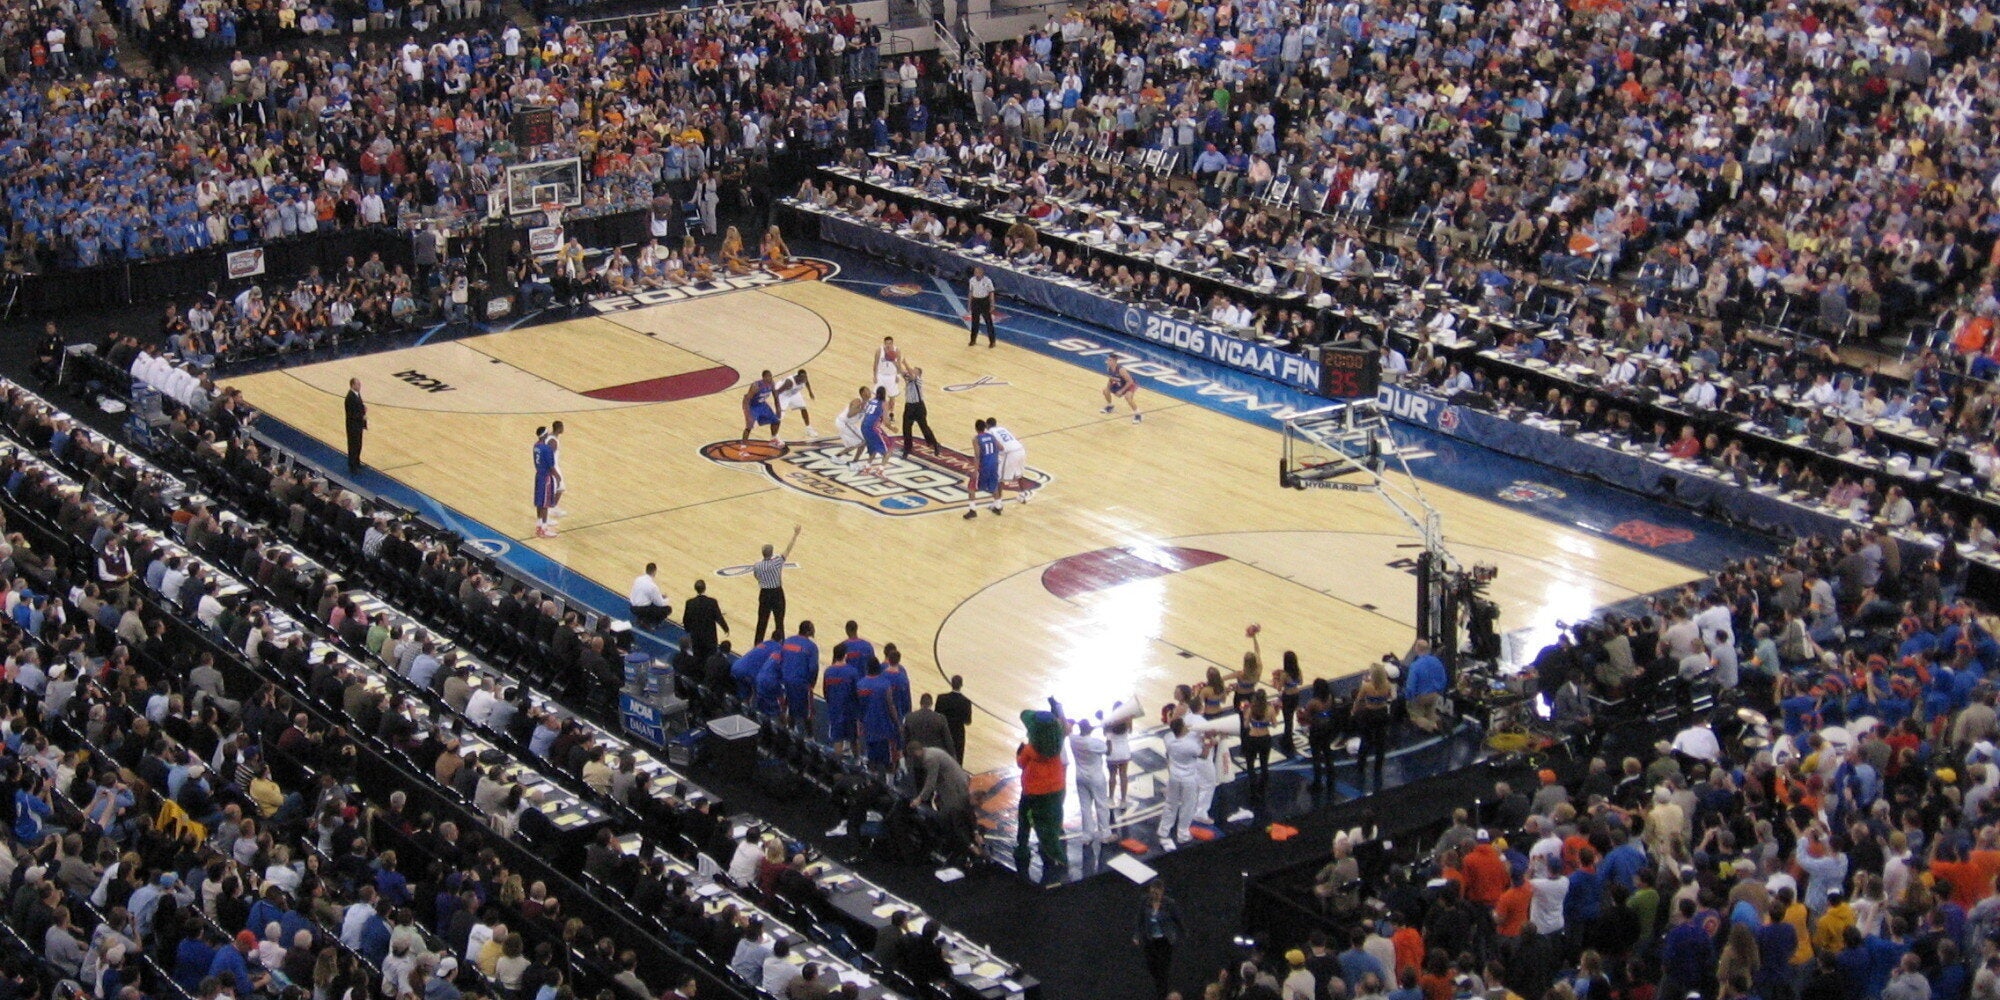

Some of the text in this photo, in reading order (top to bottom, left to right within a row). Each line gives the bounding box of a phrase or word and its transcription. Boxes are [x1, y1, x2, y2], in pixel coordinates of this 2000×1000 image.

[1145, 315, 1205, 353] 2006
[1282, 353, 1320, 390] FIN
[1376, 384, 1428, 424] OUR
[1331, 369, 1359, 397] 35
[985, 442, 994, 454] 11
[629, 698, 654, 721] NCAA
